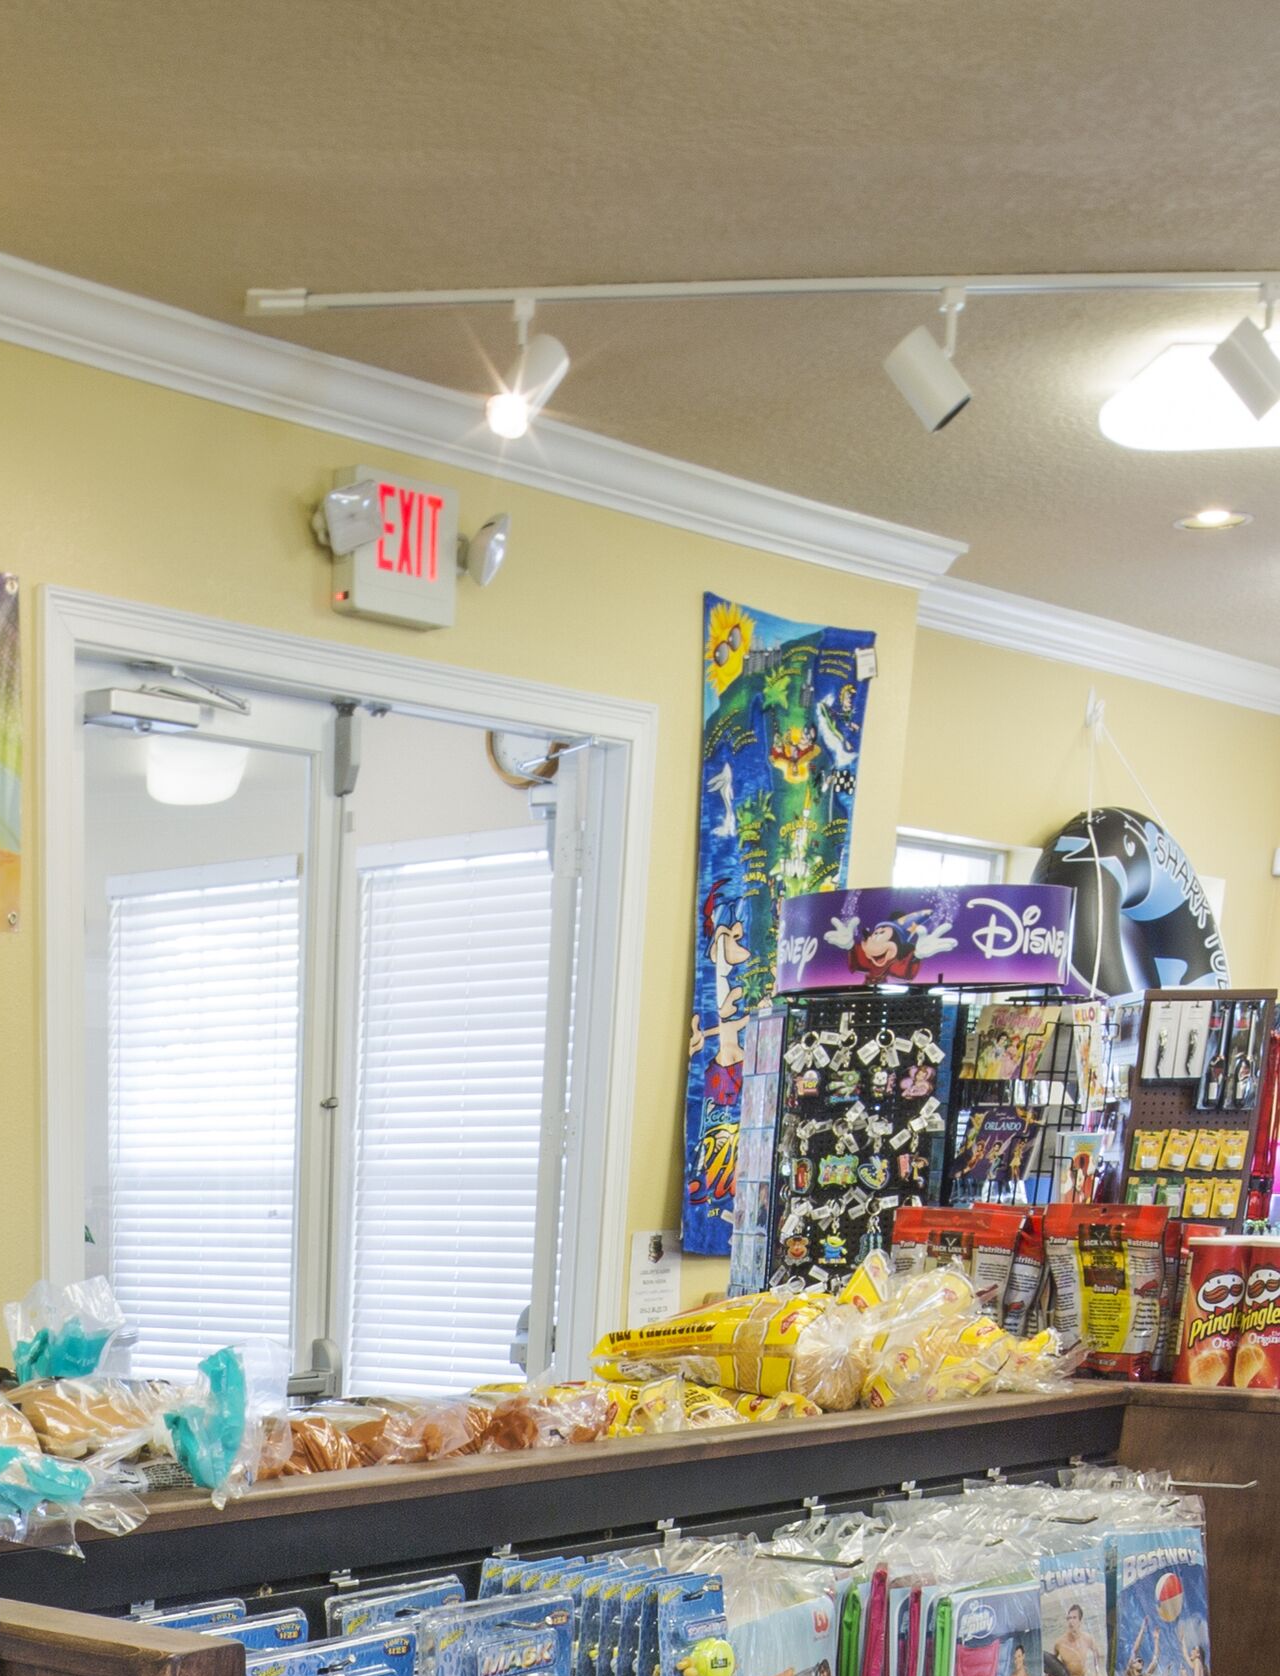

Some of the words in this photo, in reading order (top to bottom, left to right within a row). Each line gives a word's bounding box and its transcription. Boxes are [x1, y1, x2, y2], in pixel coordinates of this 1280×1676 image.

[377, 483, 443, 581] EXIT
[1155, 833, 1211, 929] SHARK
[984, 1121, 1022, 1131] ORLANDO
[978, 1245, 1011, 1254] Nutrition
[1127, 1238, 1159, 1249] Nutrition
[1123, 1548, 1200, 1582] Bestway
